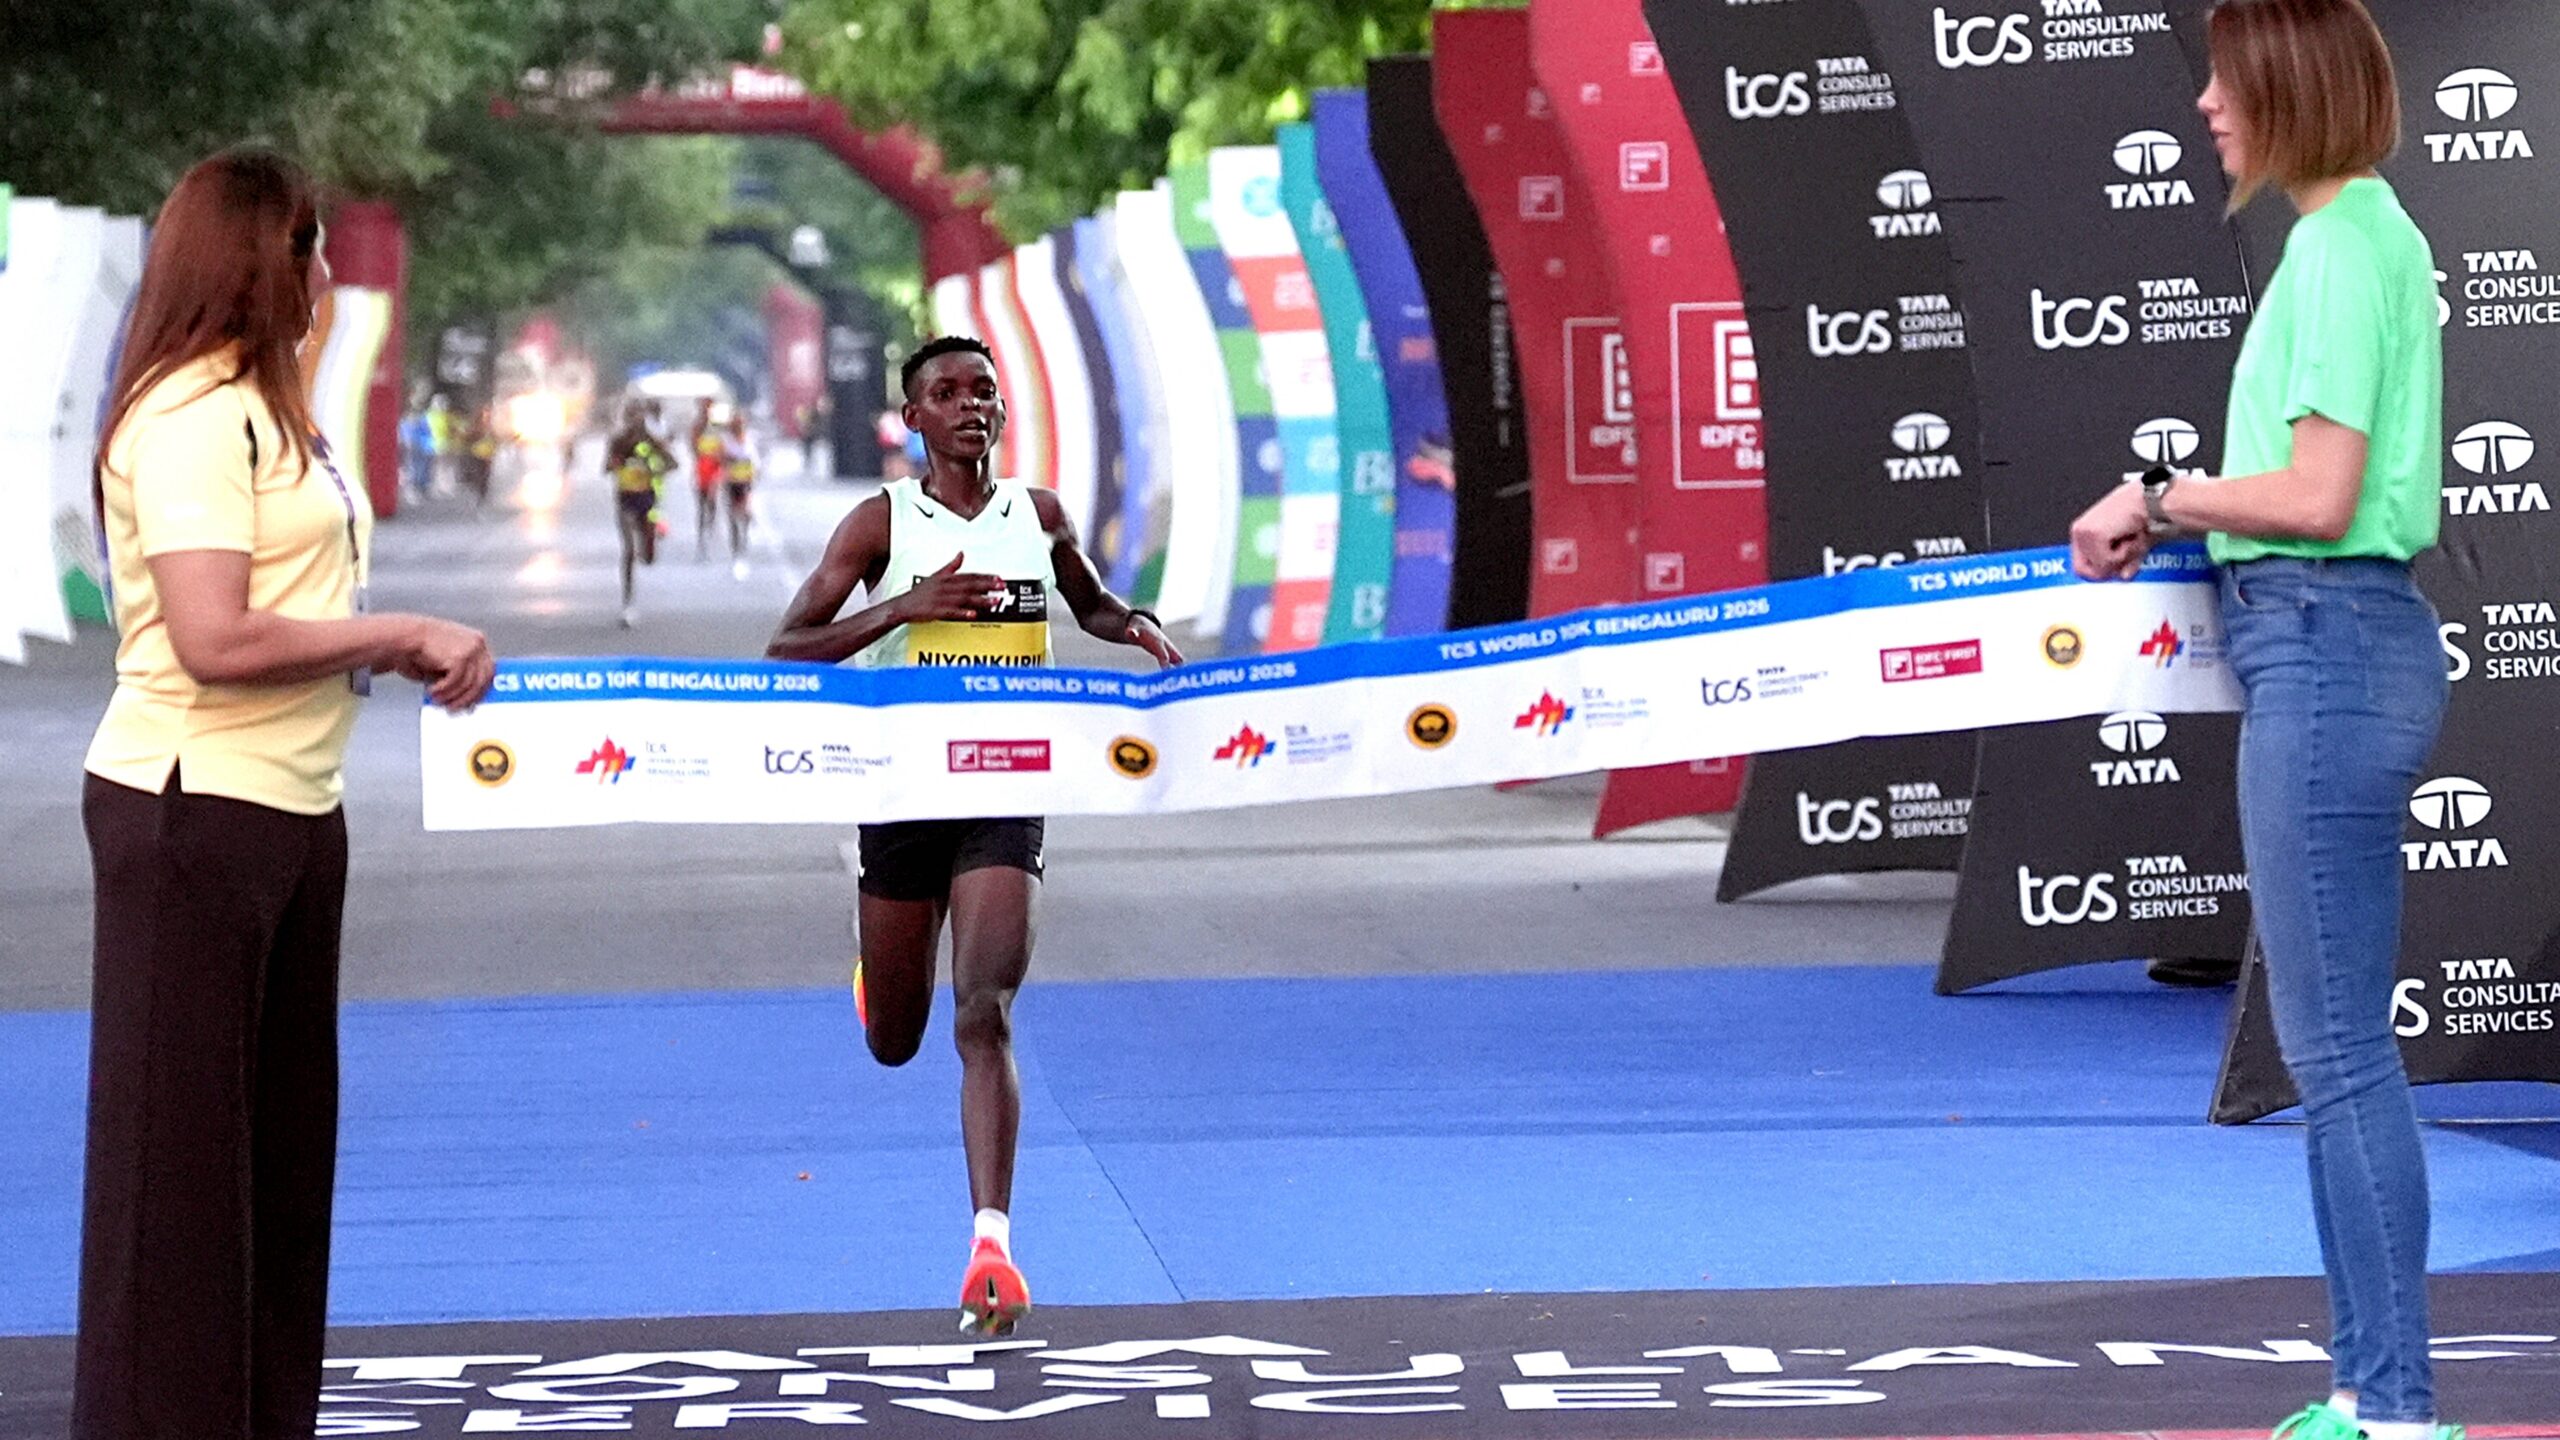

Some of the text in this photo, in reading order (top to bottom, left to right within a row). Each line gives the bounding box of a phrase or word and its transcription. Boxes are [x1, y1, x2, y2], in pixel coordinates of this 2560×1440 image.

[1933, 7, 2033, 69] tcs
[2044, 37, 2134, 61] SERVICES
[1816, 56, 1869, 75] TATA
[1725, 66, 1811, 120] tcs
[1817, 92, 1897, 113] SERVICES
[2424, 130, 2534, 162] TATA
[2103, 180, 2195, 209] TATA
[1868, 212, 1942, 238] TATA
[2463, 250, 2538, 273] TATA
[2138, 277, 2200, 298] TATA
[2464, 275, 2560, 300] CONSUL
[1898, 294, 1951, 314] TATA
[1806, 303, 1892, 357] tcs
[2031, 288, 2130, 350] tcs
[2142, 319, 2231, 343] SERVICES
[1884, 455, 1962, 481] TATA
[2441, 483, 2551, 515] TATA
[1914, 538, 1966, 556] TATA
[1908, 572, 1948, 592] TCS
[1951, 563, 2028, 587] WORLD
[2031, 558, 2067, 578] 10K
[2482, 603, 2557, 625] TATA
[1440, 640, 1477, 660] TCS
[1480, 629, 1557, 655] WORLD
[1595, 604, 1719, 635] BENGALURU
[1722, 597, 1770, 620] 2026
[493, 671, 822, 691] CS WORLD 10K BENGALURU 2026
[961, 661, 1297, 700] TCS WORLD 10K BENGALURU 2026
[1701, 677, 1751, 706] tcs
[765, 744, 814, 774] tcs
[2091, 757, 2181, 787] TATA
[1887, 782, 1941, 801] TATA
[1796, 791, 1883, 845] tcs
[1890, 817, 1969, 839] SERVICES
[2126, 855, 2187, 876] TATA
[2401, 838, 2509, 870] TATA
[2018, 865, 2118, 926] tcs
[2129, 897, 2219, 920] SERVICES
[2441, 958, 2516, 981] TATA
[2445, 1009, 2554, 1035] SERVICES
[321, 1335, 1332, 1380] TATA
